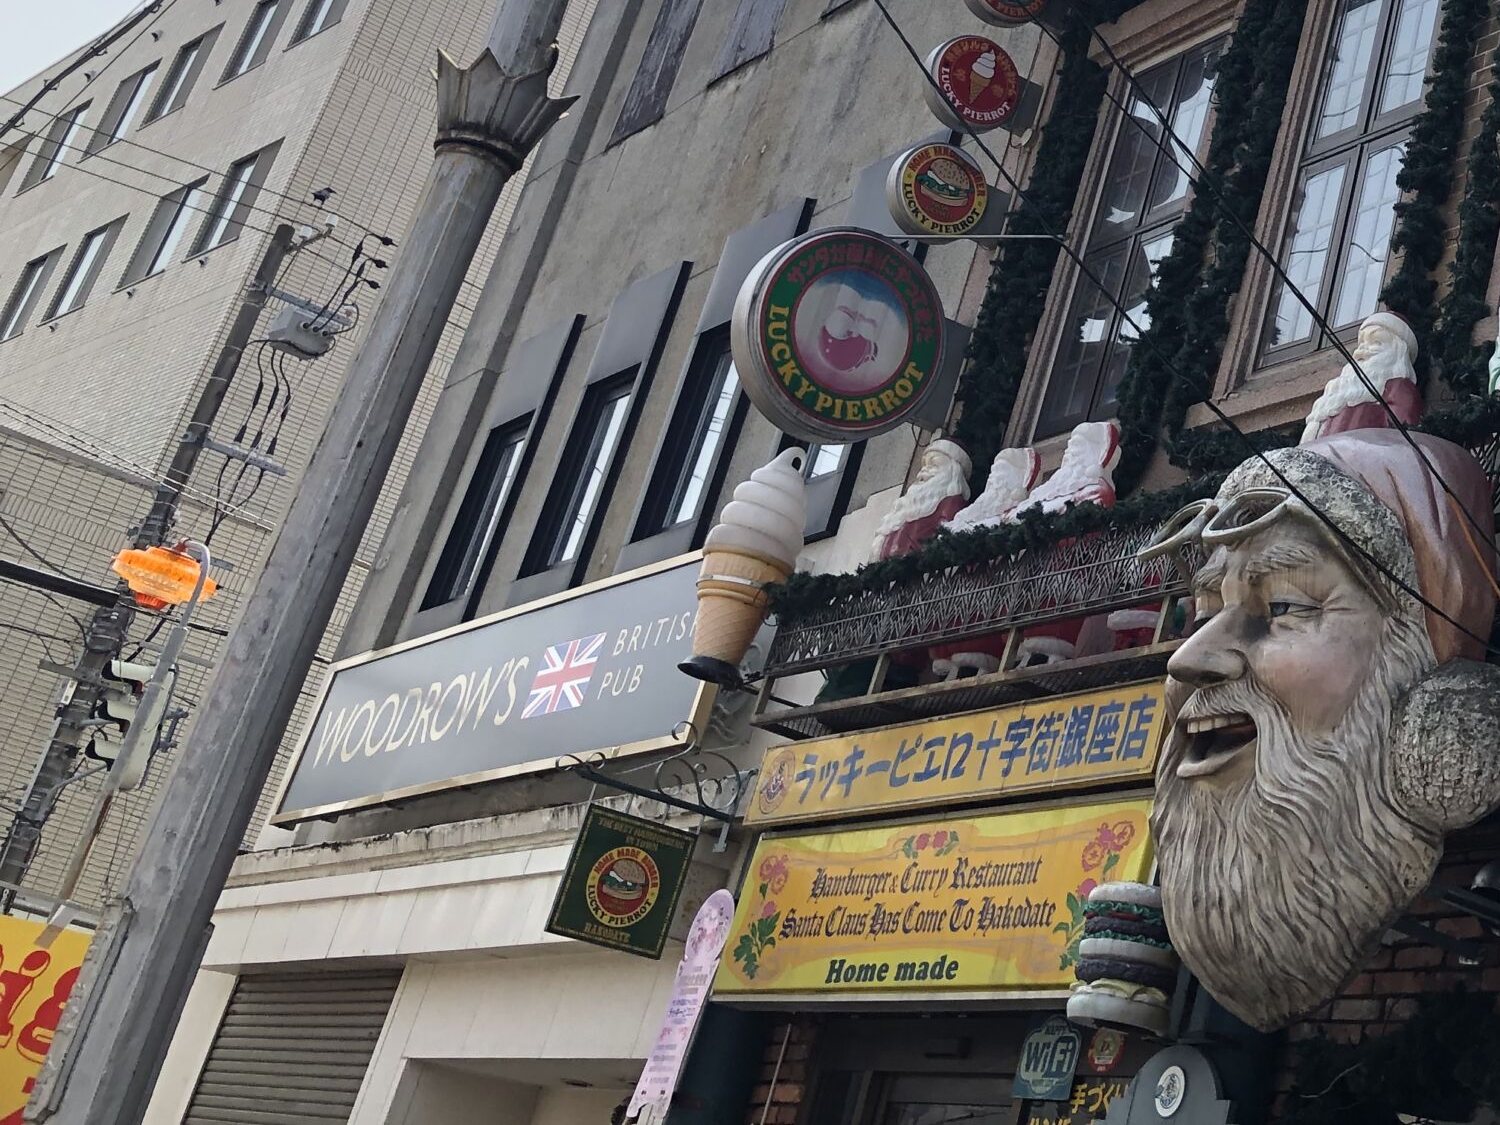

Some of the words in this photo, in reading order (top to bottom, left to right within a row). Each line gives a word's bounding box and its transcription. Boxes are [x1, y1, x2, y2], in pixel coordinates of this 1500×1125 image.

[941, 67, 962, 108] LUCKY
[963, 101, 1011, 121] PIERROT
[908, 149, 932, 172] HOME
[904, 183, 929, 224] LUCKY
[930, 208, 980, 234] PIERROT
[767, 304, 816, 399] LUCKY
[814, 361, 926, 421] PIERROT
[598, 664, 644, 696] PUB
[313, 656, 530, 770] WOODROW'S
[797, 693, 1158, 804] ラッキーピエロ十字街銀座店
[807, 866, 891, 904] Hamburger
[900, 861, 949, 899] Curry
[948, 855, 1043, 890] Restaurant
[588, 884, 608, 923] LUCKY
[608, 899, 653, 925] PIERROT
[779, 907, 824, 941] Santa
[825, 905, 869, 938] Claus
[866, 901, 901, 941] Has
[902, 900, 948, 938] Come
[949, 898, 976, 933] To
[973, 895, 1057, 938] Hakodate
[824, 958, 890, 985] Home
[894, 955, 959, 981] made
[1025, 1040, 1075, 1073] WiFi
